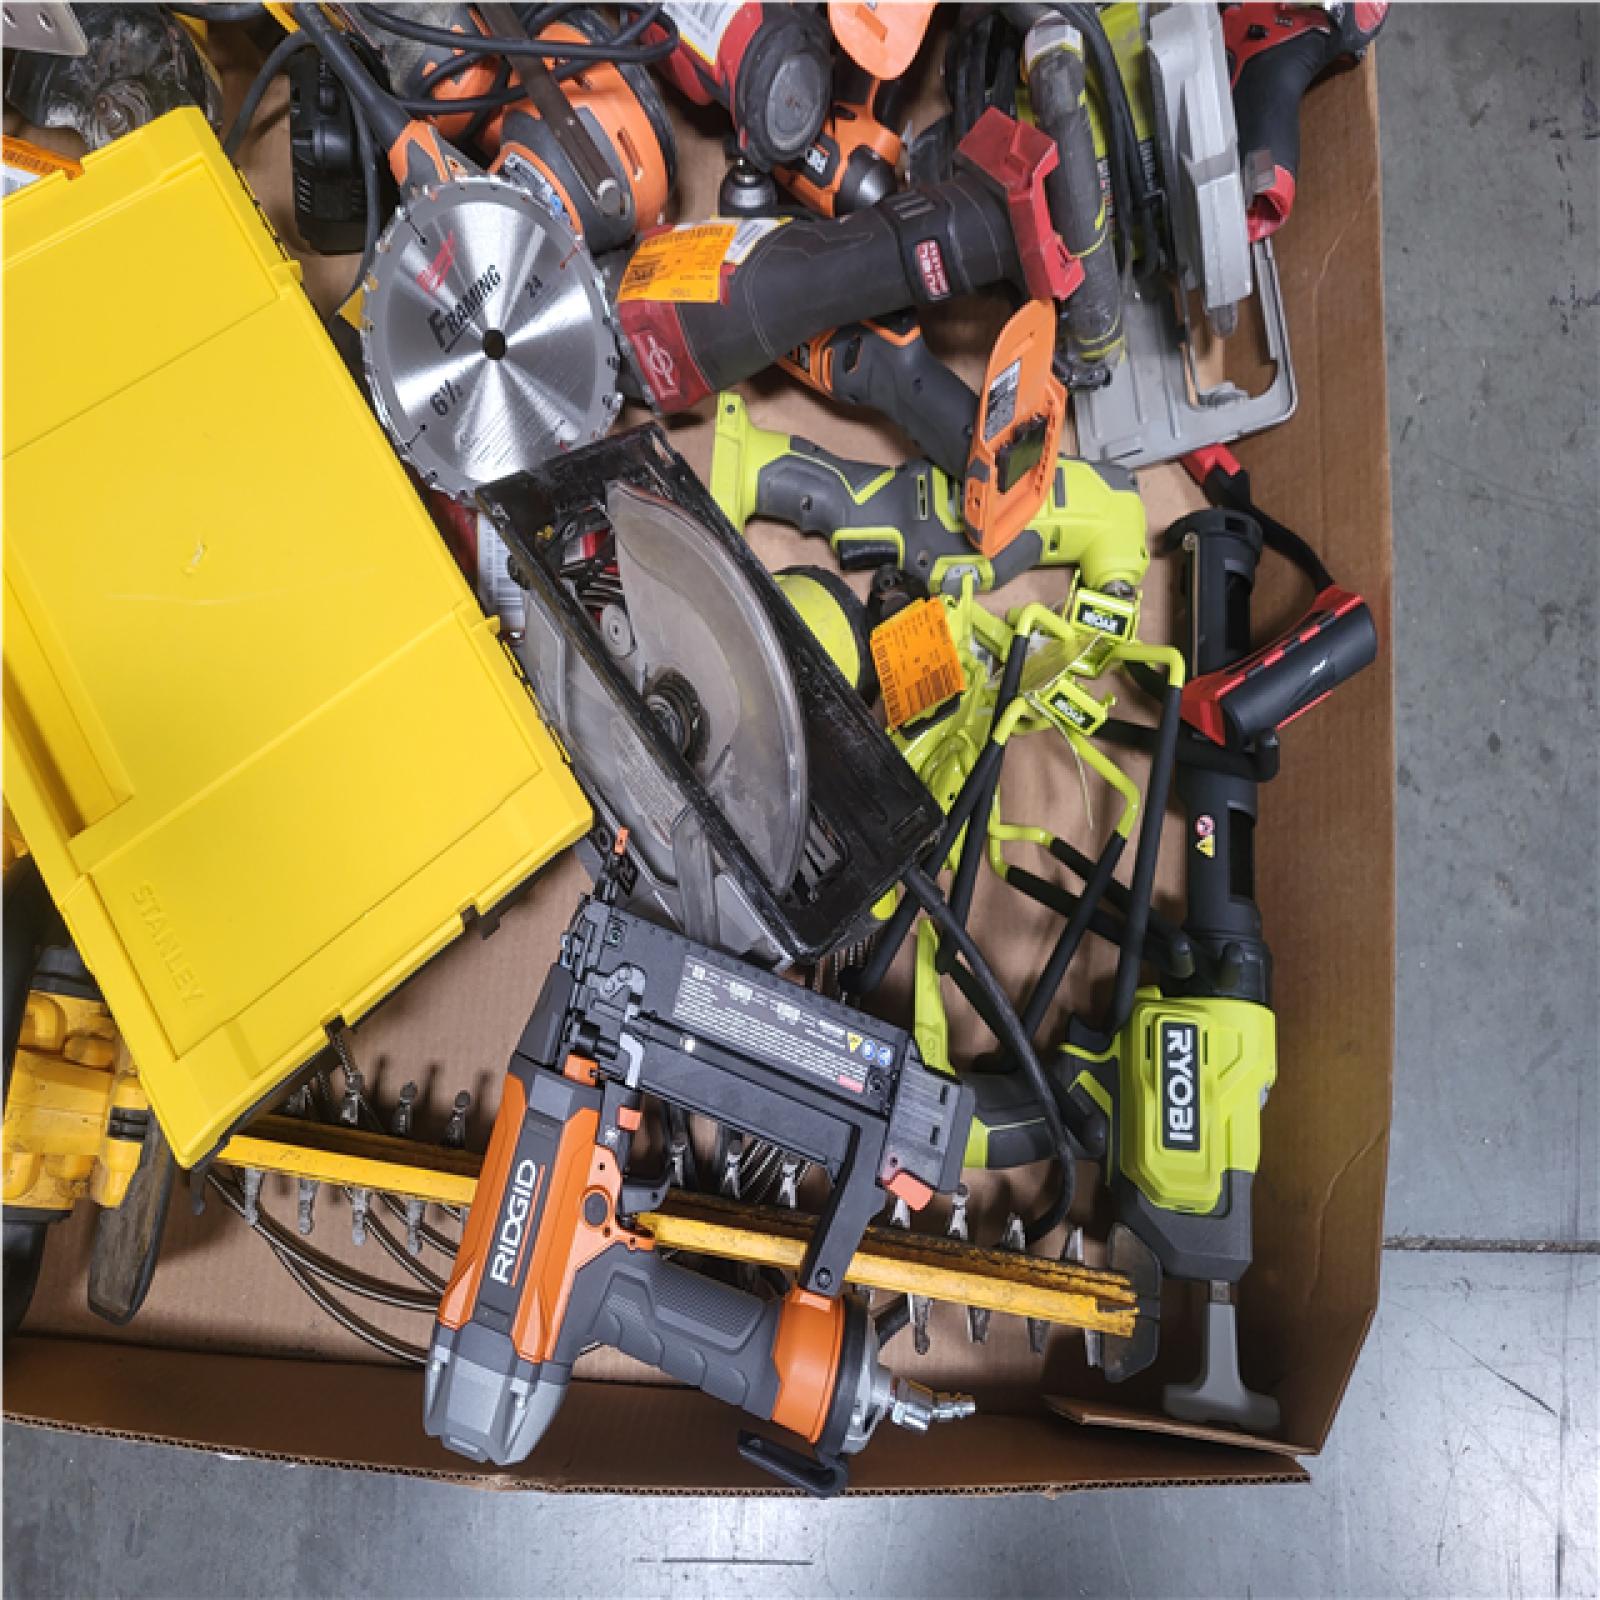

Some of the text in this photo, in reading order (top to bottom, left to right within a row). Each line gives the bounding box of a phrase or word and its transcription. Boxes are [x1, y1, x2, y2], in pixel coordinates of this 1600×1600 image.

[427, 264, 501, 349] FRAMING
[129, 881, 206, 1005] STANLEY
[1166, 1028, 1194, 1142] RYOBI
[489, 1159, 537, 1285] RIDGID
